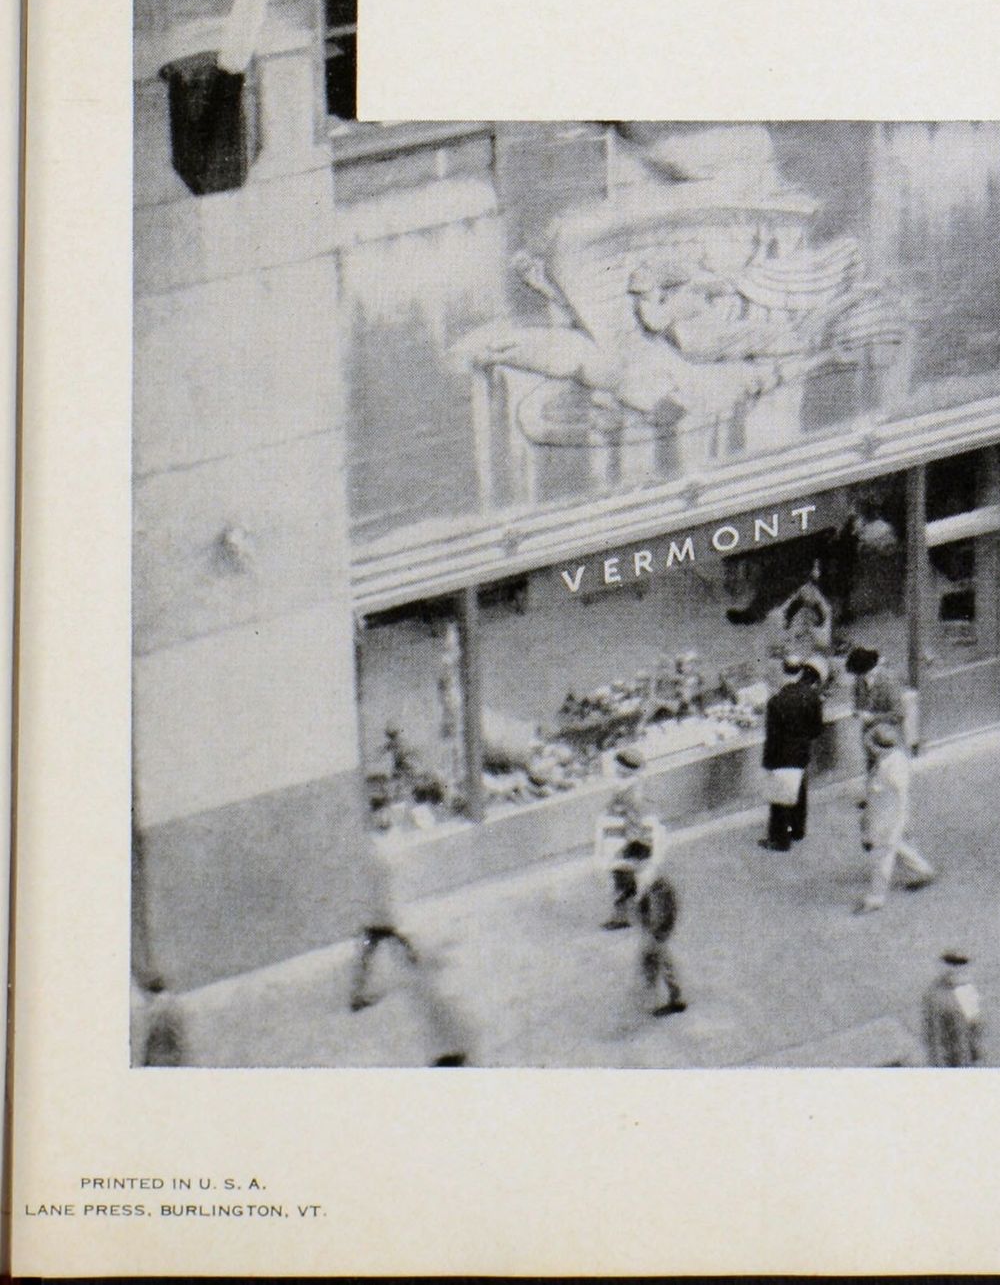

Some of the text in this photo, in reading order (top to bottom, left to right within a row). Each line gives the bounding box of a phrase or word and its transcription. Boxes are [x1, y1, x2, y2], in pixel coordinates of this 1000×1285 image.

[561, 505, 816, 593] VERMONT
[80, 1177, 164, 1190] PRINTED
[172, 1178, 191, 1190] IN
[25, 1204, 75, 1216] LANE
[160, 1204, 289, 1218] BURLINGTON,
[297, 1205, 327, 1217] VT.
